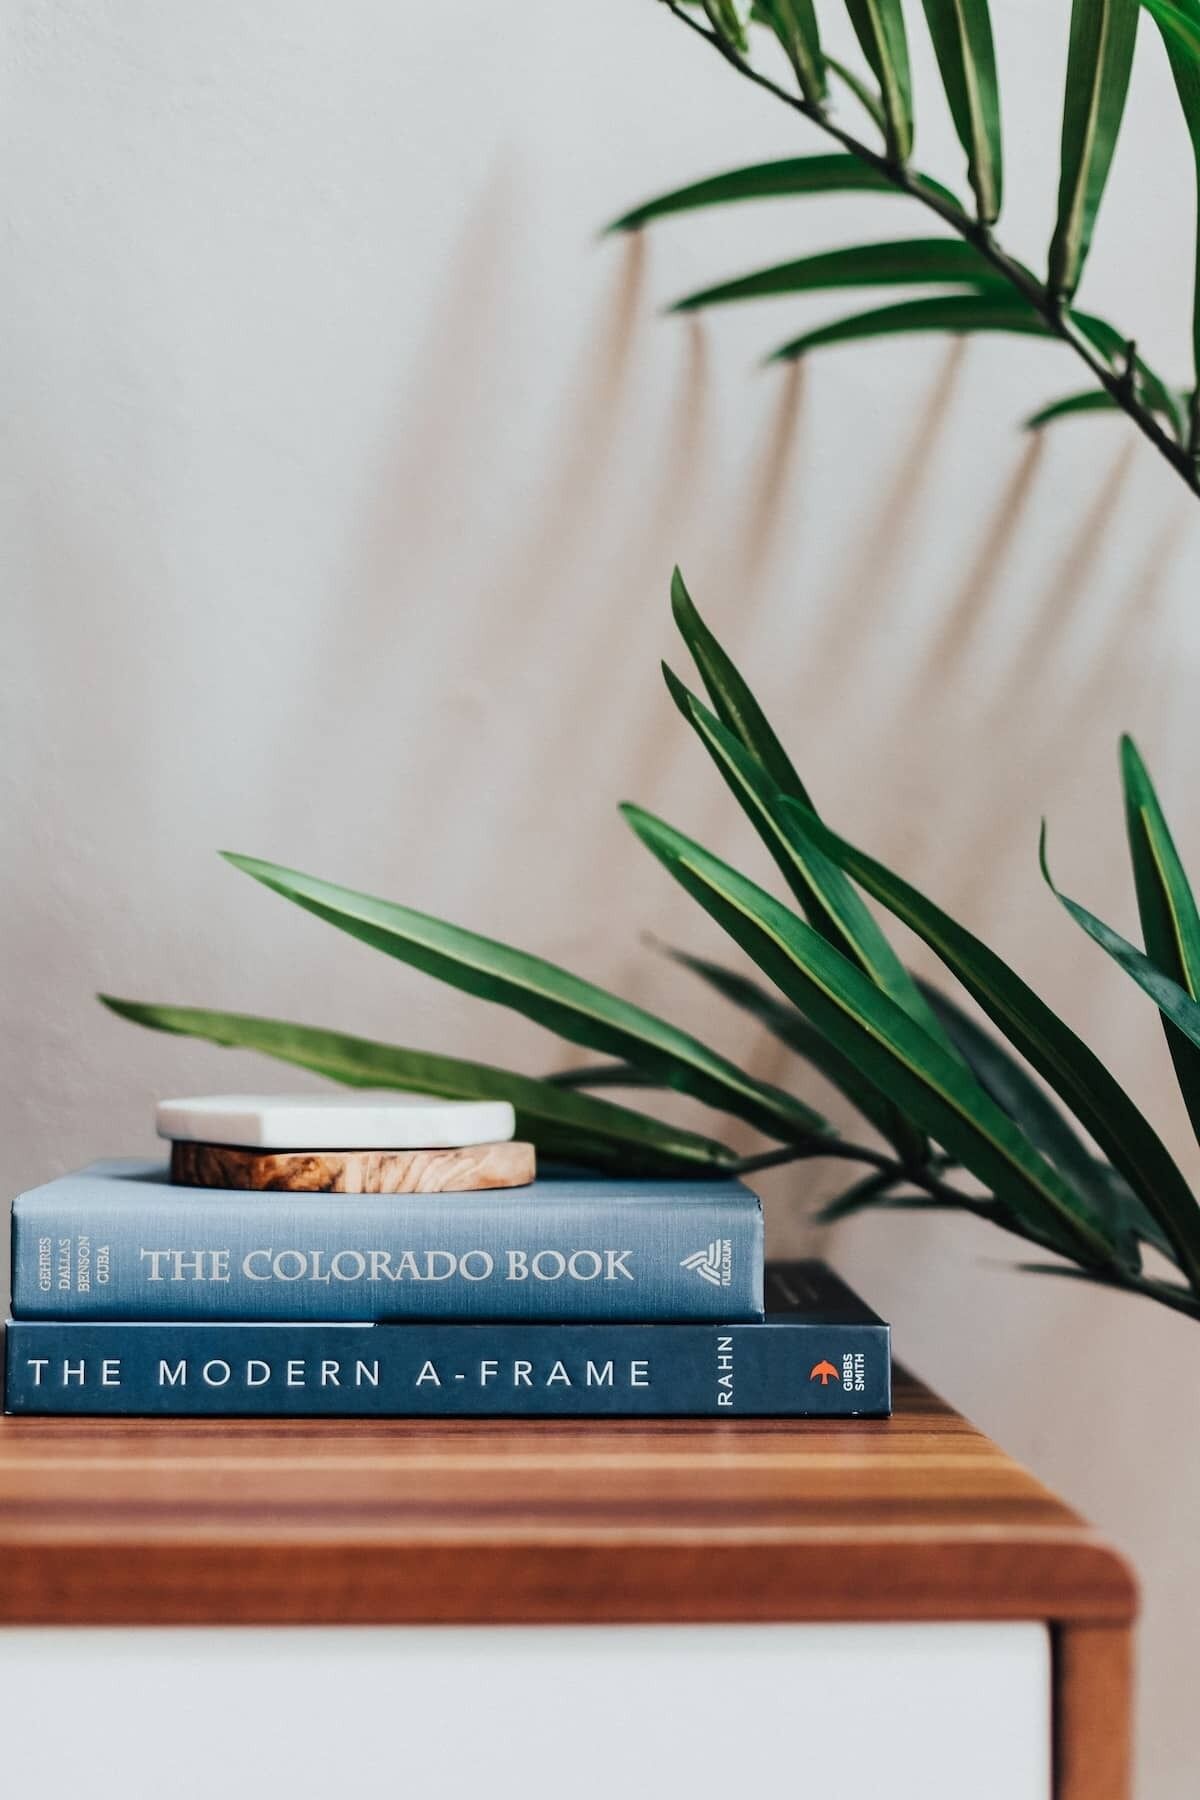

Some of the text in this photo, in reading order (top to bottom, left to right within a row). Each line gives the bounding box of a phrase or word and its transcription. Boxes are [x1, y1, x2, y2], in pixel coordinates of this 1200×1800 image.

[40, 1237, 51, 1291] GEHRES
[59, 1239, 70, 1290] DALLAS
[78, 1236, 90, 1293] BENSON
[97, 1246, 110, 1284] CUBA
[140, 1248, 635, 1285] THE COLORADO BOOK
[721, 1239, 732, 1286] FULCRUM
[27, 1359, 650, 1386] THE MODERN A-FRAME
[717, 1336, 733, 1406] RAHN
[843, 1353, 854, 1392] GIBBS
[854, 1353, 865, 1391] SMITH
